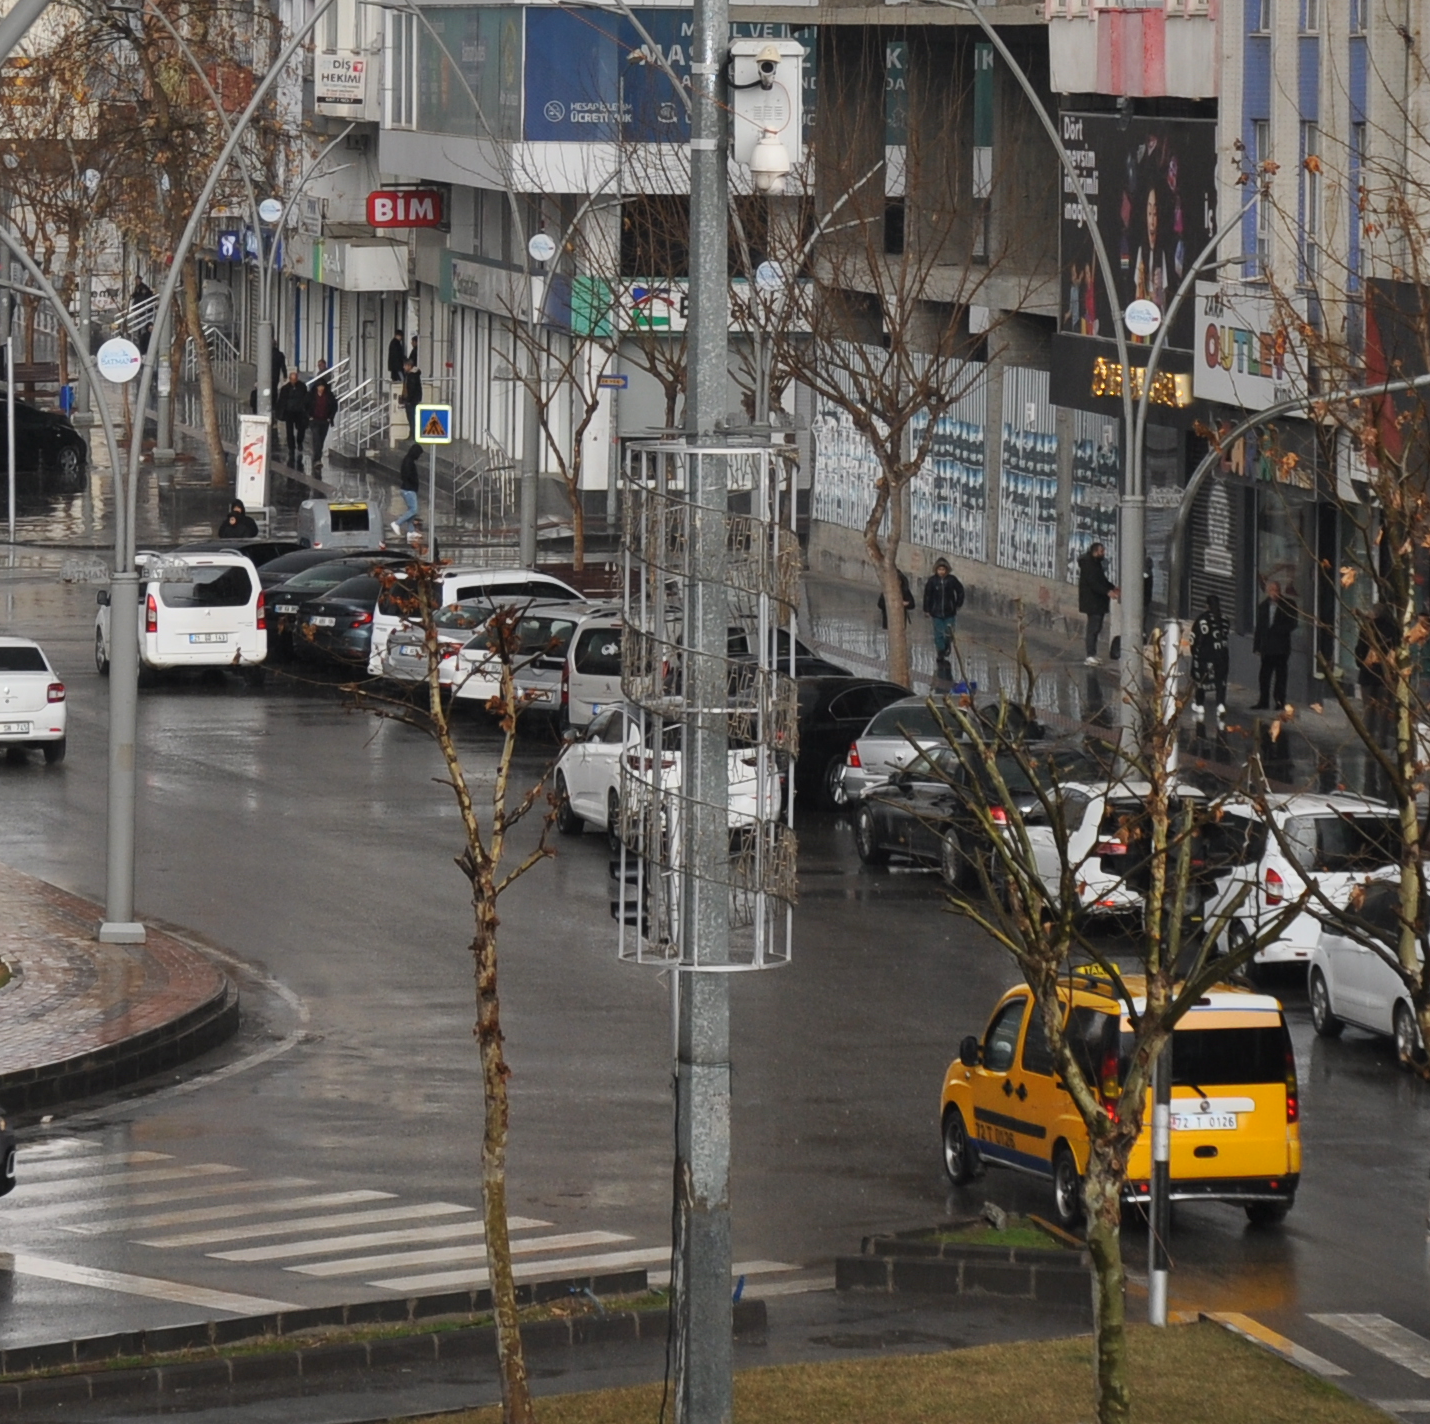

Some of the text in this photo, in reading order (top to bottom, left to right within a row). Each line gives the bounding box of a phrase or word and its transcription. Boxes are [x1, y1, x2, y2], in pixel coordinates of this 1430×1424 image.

[332, 58, 352, 72] DİŞ
[1064, 116, 1084, 141] Dört
[374, 192, 434, 222] BİM
[1209, 1117, 1235, 1128] 0126
